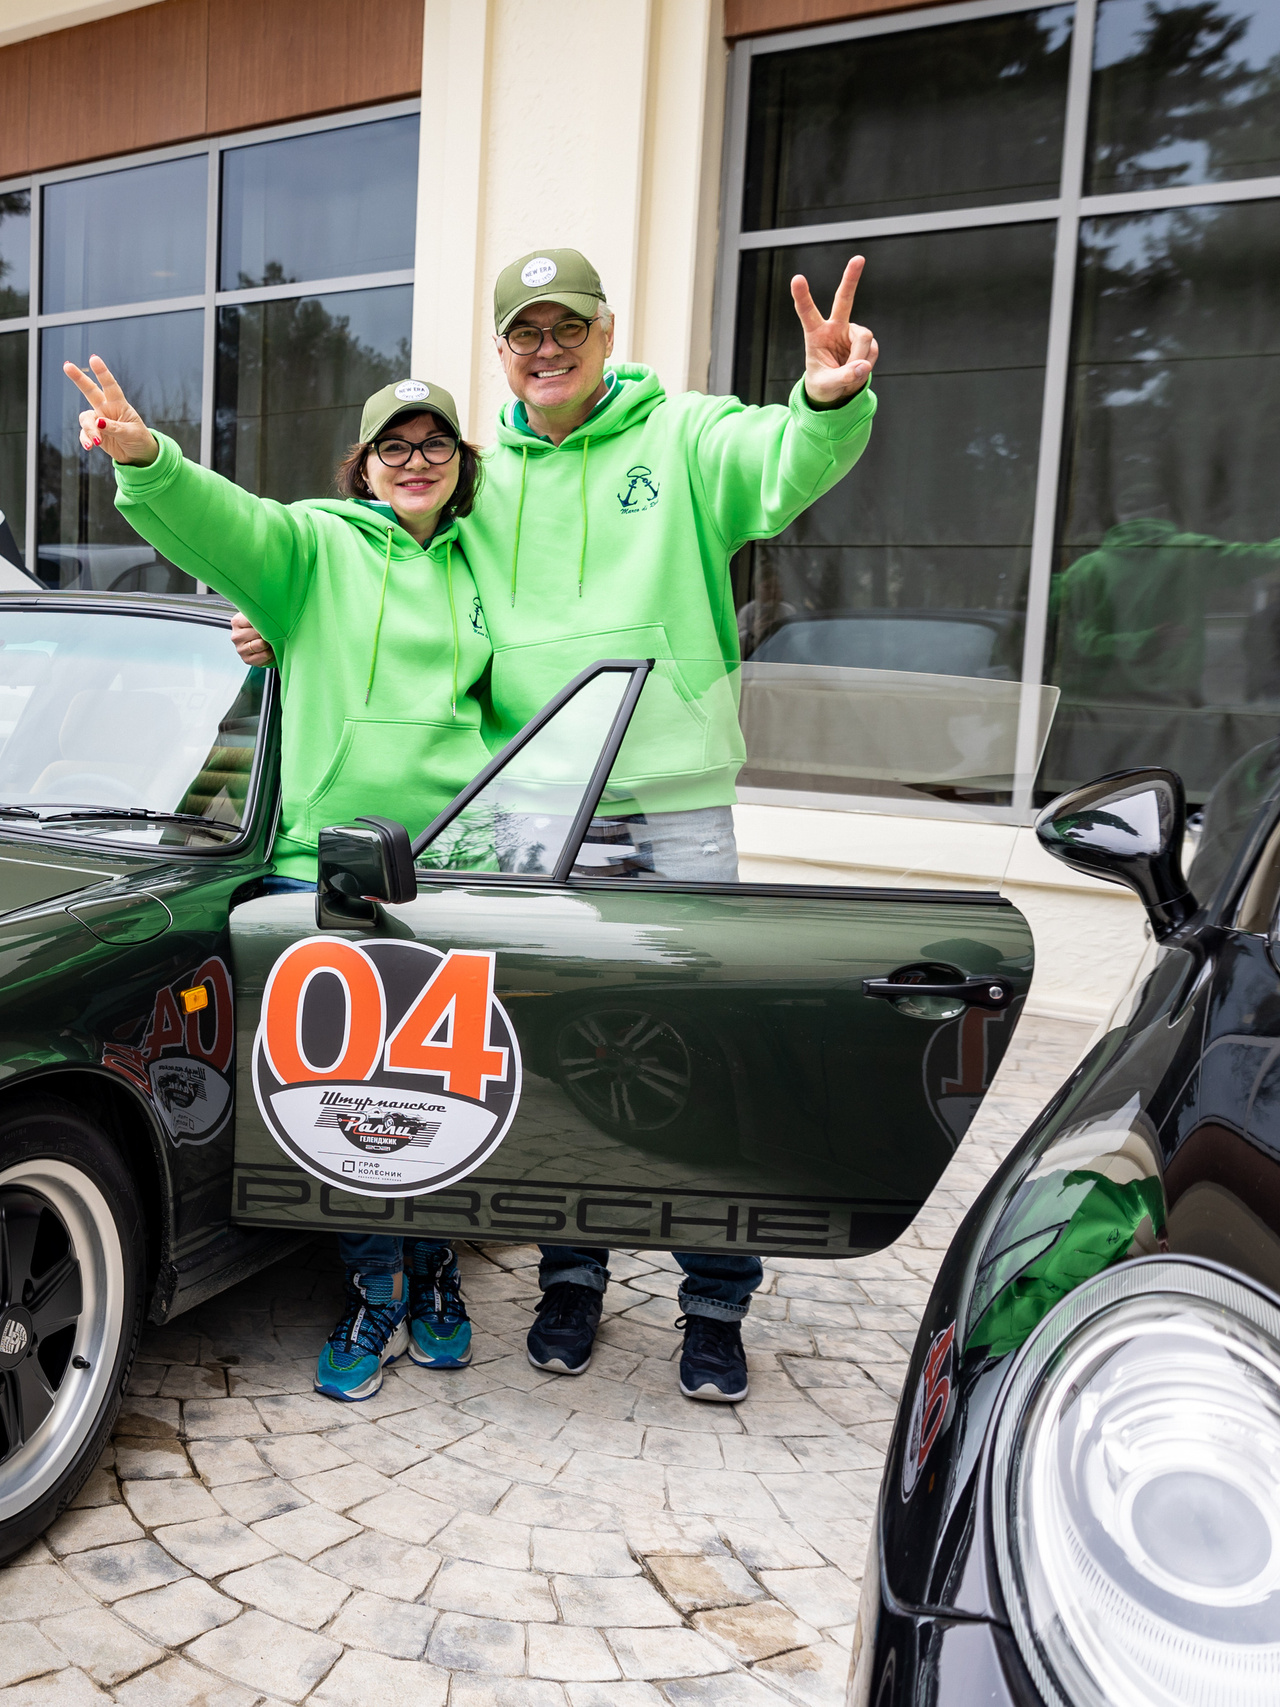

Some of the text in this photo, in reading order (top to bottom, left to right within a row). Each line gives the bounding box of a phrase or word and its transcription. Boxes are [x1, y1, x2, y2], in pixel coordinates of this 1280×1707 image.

[525, 268, 538, 278] NEW
[260, 935, 510, 1103] 04
[319, 1091, 447, 1113] Штурманское
[345, 1113, 411, 1136] Ралли
[359, 1135, 397, 1145] ГЕЛЕНДЖИК
[358, 1168, 402, 1178] КОЛЕСНИК
[238, 1175, 829, 1248] PORSCHE
